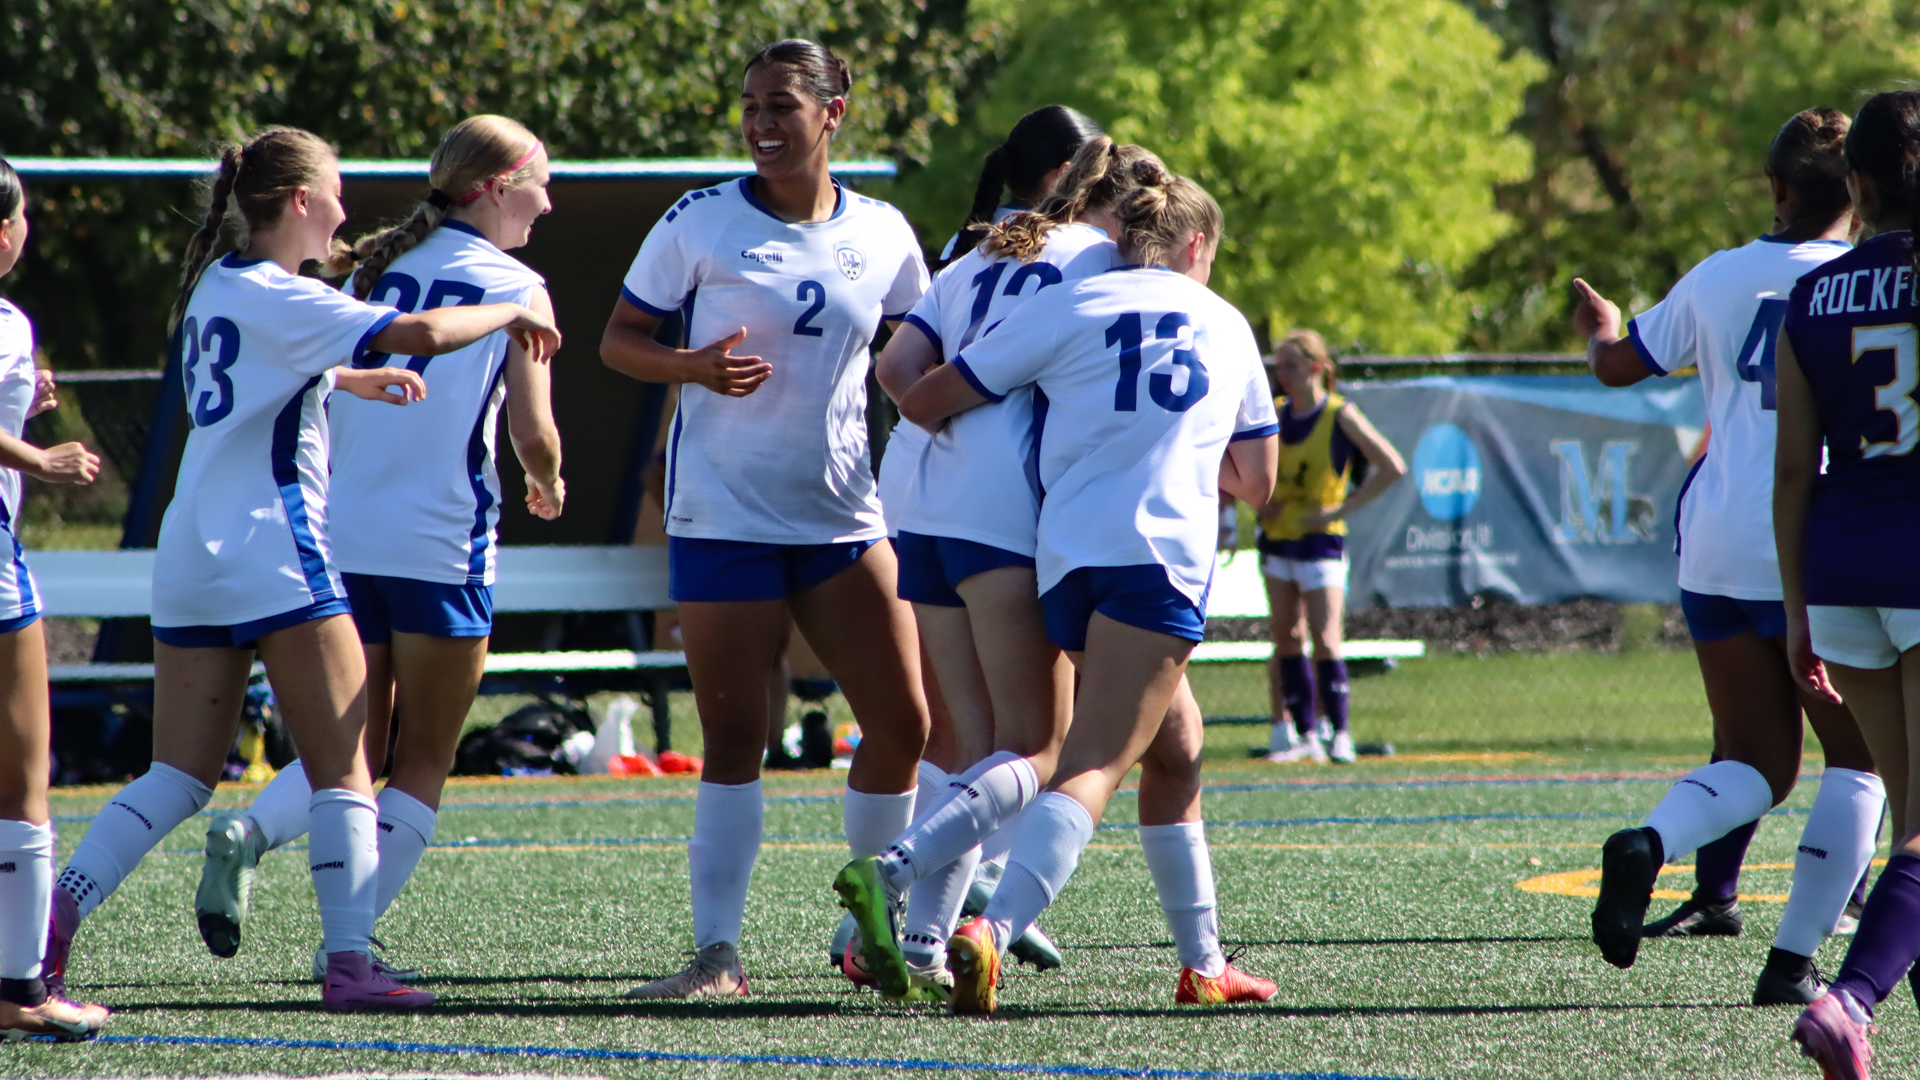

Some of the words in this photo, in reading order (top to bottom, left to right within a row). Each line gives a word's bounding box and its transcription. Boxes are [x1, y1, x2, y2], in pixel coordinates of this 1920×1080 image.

[741, 250, 783, 263] capelli
[793, 280, 825, 337] 2
[1736, 298, 1790, 411] 4
[1105, 311, 1210, 412] 13
[1851, 322, 1920, 459] 3
